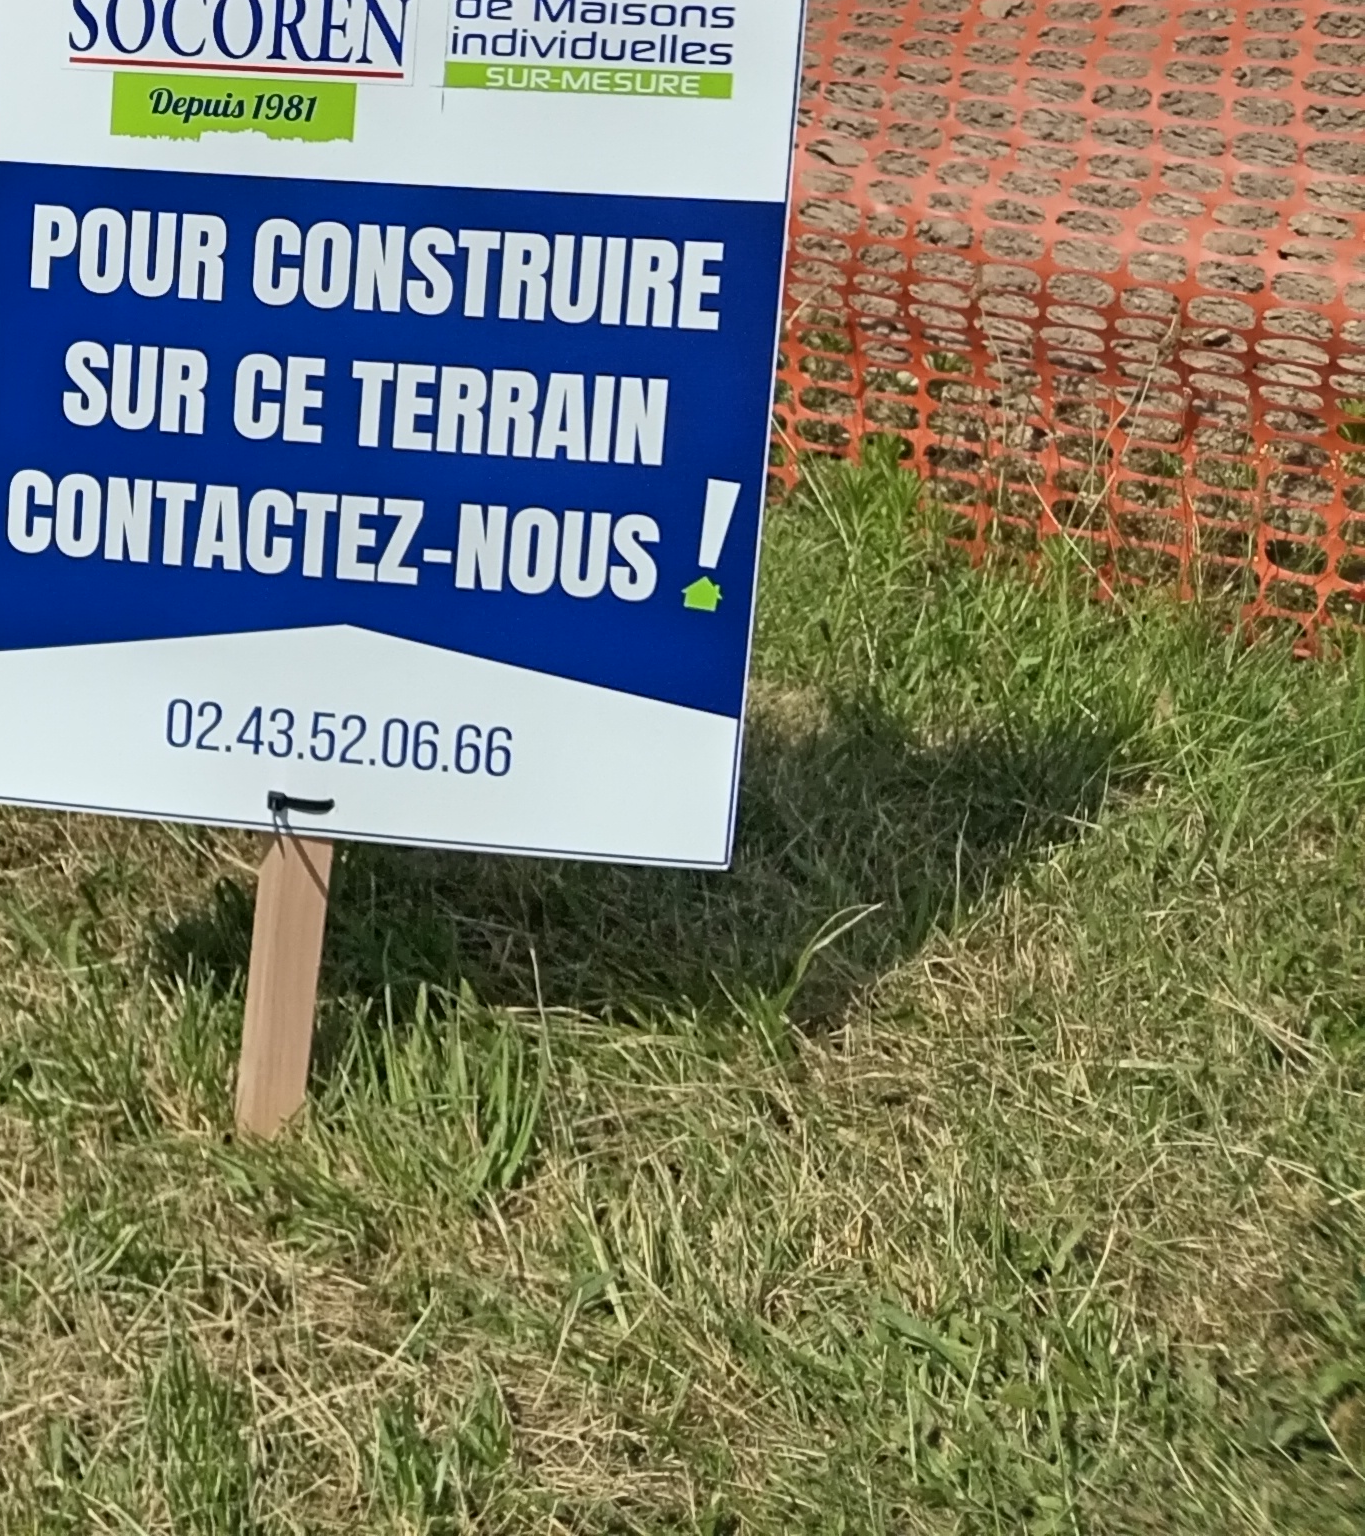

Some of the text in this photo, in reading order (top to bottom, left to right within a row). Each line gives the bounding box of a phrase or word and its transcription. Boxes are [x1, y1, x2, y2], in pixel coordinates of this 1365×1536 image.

[451, 26, 733, 66] individuelles
[485, 66, 701, 96] SUR-MESURE
[149, 87, 318, 124] Depuis 1981
[29, 203, 725, 331] POUR CONSTRUIRE
[62, 340, 669, 466] SUR CE TERRAIN
[6, 469, 741, 611] CONTACTEZ-NOUS !
[165, 697, 514, 776] 02.43.52.06.66
